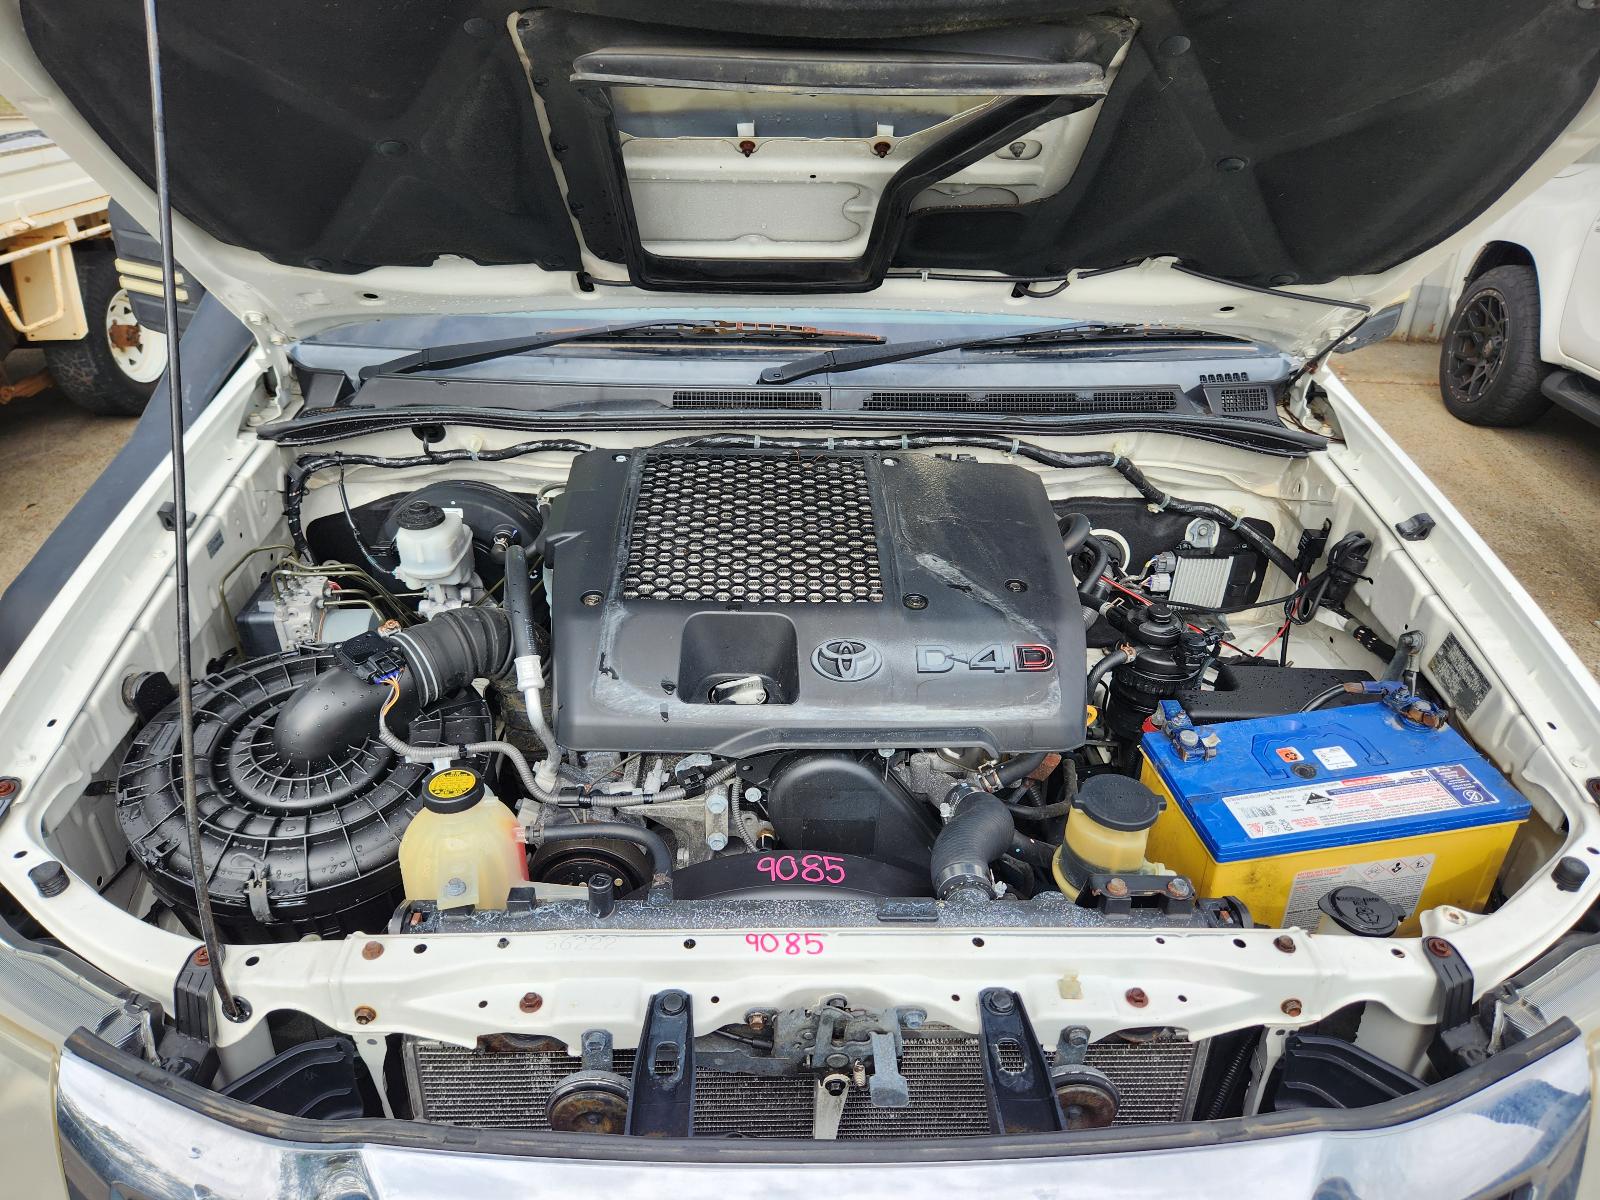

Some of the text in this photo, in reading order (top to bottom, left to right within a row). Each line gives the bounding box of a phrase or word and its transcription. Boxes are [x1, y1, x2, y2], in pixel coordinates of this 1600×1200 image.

[915, 643, 1055, 673] D-4D
[756, 854, 846, 884] 9085
[745, 933, 824, 955] 9085
